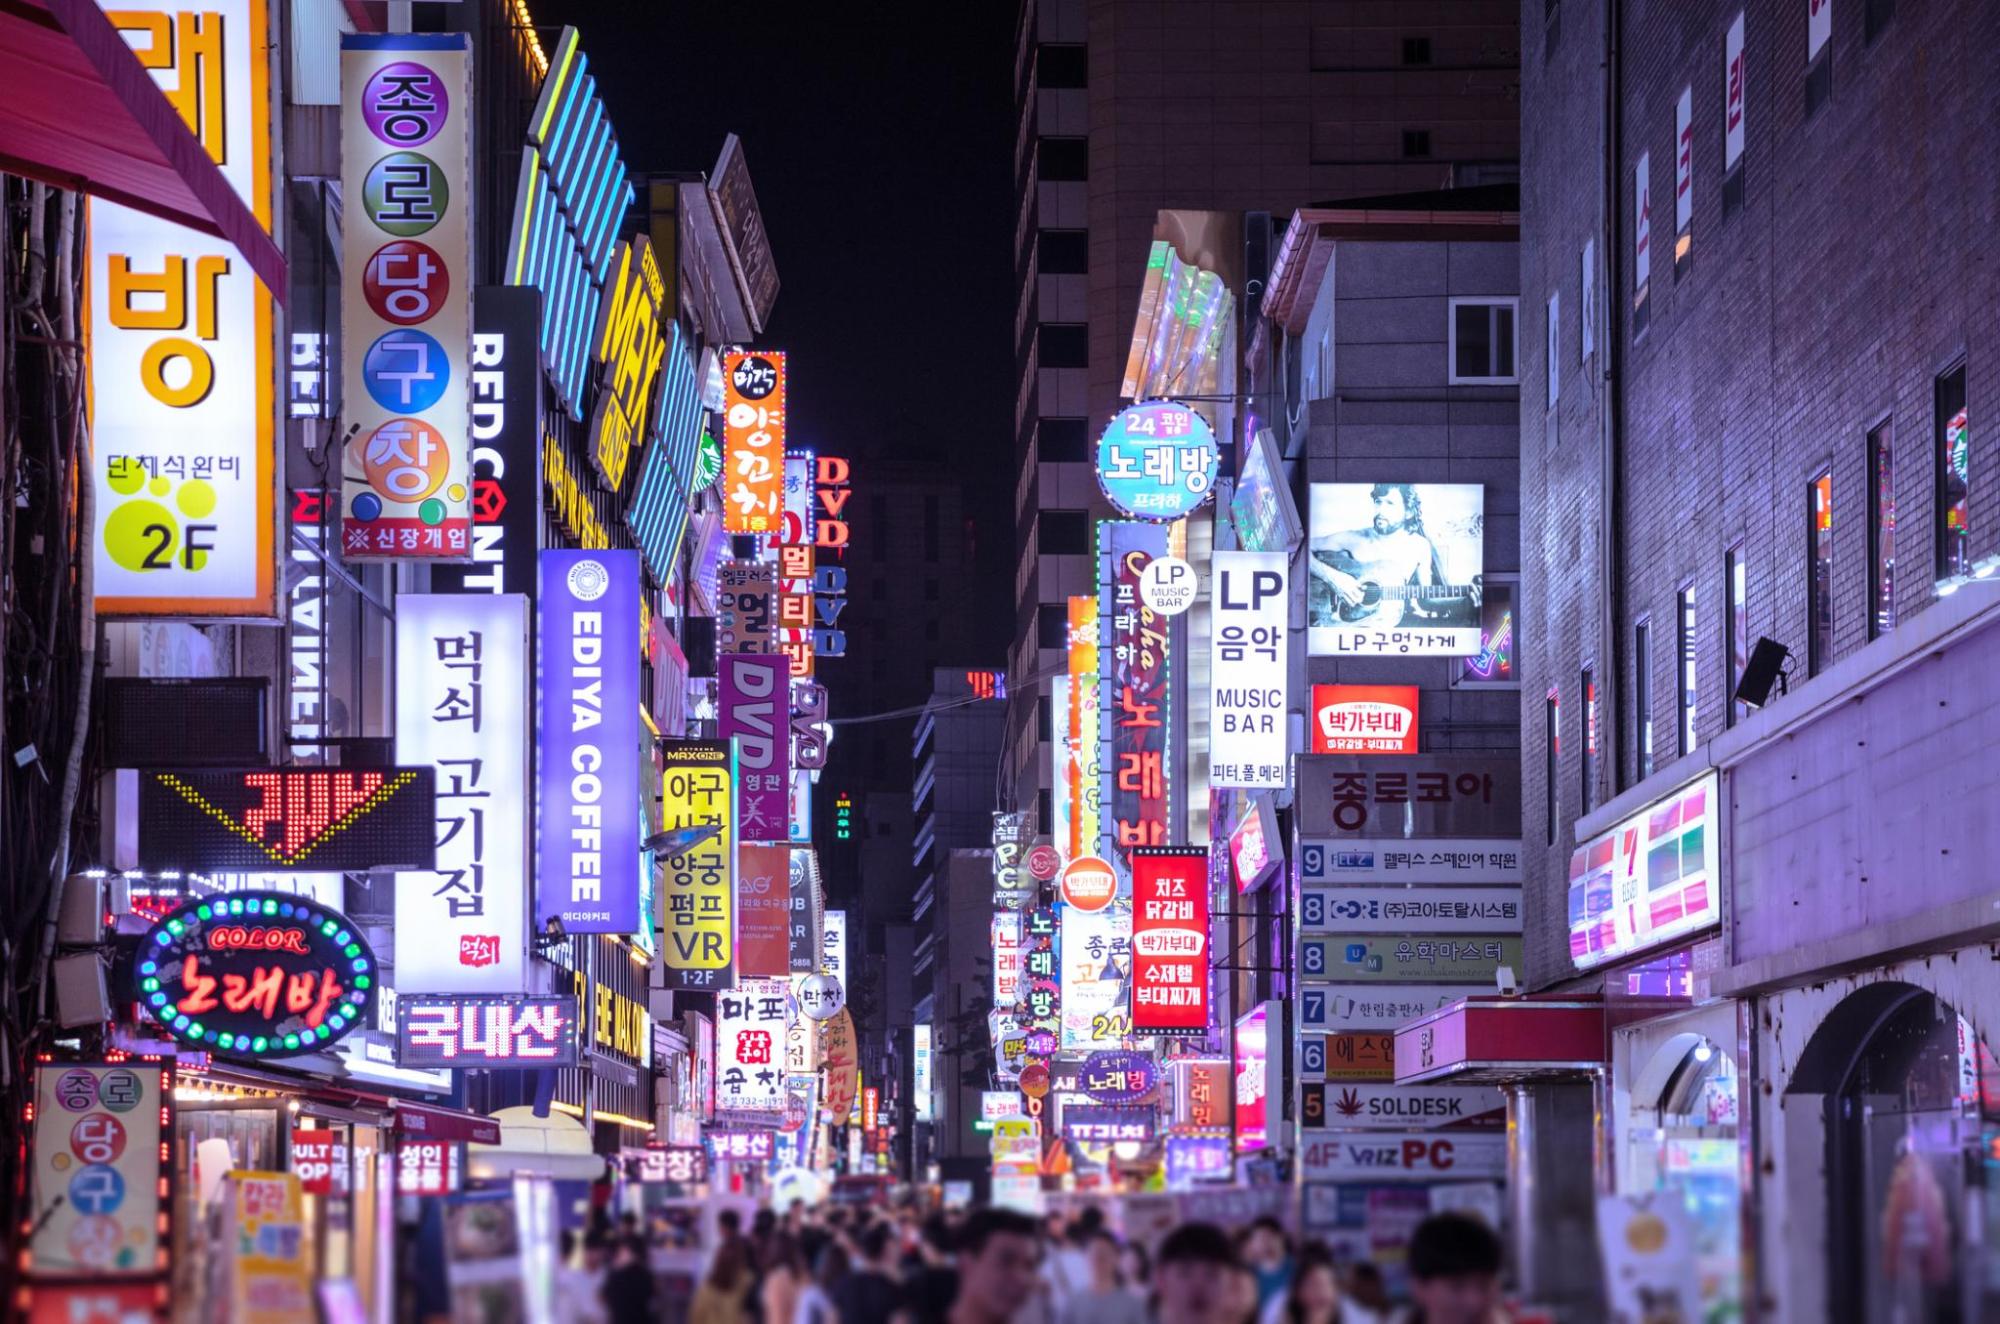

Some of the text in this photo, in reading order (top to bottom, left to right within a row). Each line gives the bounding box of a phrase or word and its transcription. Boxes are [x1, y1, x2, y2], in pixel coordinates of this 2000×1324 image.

[372, 73, 438, 497] 종로당구장
[1127, 413, 1156, 436] 24
[107, 455, 241, 480] 단체석완비
[1104, 445, 1214, 494] 노래방
[815, 456, 852, 547] DVD
[140, 523, 217, 570] 2F
[376, 527, 467, 550] 신장개업
[1155, 565, 1185, 585] LP
[1151, 586, 1190, 598] MUSIC
[1156, 597, 1183, 608] BAR
[1219, 570, 1284, 611] LP
[782, 545, 813, 676] 멀티방
[814, 565, 849, 658] DVD
[1115, 584, 1138, 666] 프라하
[1216, 626, 1282, 663] 음악
[432, 631, 483, 733] 먹쇠
[1216, 687, 1282, 709] MUSIC
[732, 660, 775, 770] DVD
[1223, 714, 1274, 734] BAR
[1329, 711, 1402, 732] 박가부대
[570, 611, 602, 903] EDIYA COFFEE
[670, 773, 725, 806] 야구
[1332, 772, 1494, 831] 종로코아
[739, 796, 767, 828] 美
[670, 853, 725, 887] 양궁
[1304, 849, 1322, 873] 9
[1384, 852, 1426, 870] 펠리스
[1429, 852, 1485, 870] 스페인어
[1489, 852, 1518, 870] 학원
[1155, 877, 1186, 897] 치즈
[669, 893, 726, 926] 펌프
[1145, 901, 1194, 920] 닭갈비
[1304, 897, 1322, 922] 8
[210, 926, 310, 953] COLOR
[461, 937, 498, 965] 먹쇠
[672, 930, 725, 961] VR
[1141, 935, 1198, 951] 박가부대
[1030, 912, 1054, 1016] 노래방
[1304, 946, 1322, 971] 8
[1395, 941, 1503, 965] 유학마스터
[1145, 964, 1193, 983] 수제햄
[176, 953, 344, 1030] 노래방
[1136, 986, 1201, 1005] 부대찌개
[721, 996, 785, 1021] 마포
[1306, 997, 1425, 1019] 7 한림출판사
[407, 1004, 564, 1057] 국내산
[1304, 1044, 1322, 1068] 6
[62, 1074, 136, 1109] 종로
[723, 1067, 786, 1095] 곱창
[1088, 1070, 1146, 1091] 노래방
[1305, 1092, 1463, 1117] 5 SOLDESK
[1303, 1142, 1340, 1168] 4F
[1401, 1140, 1455, 1170] PC
